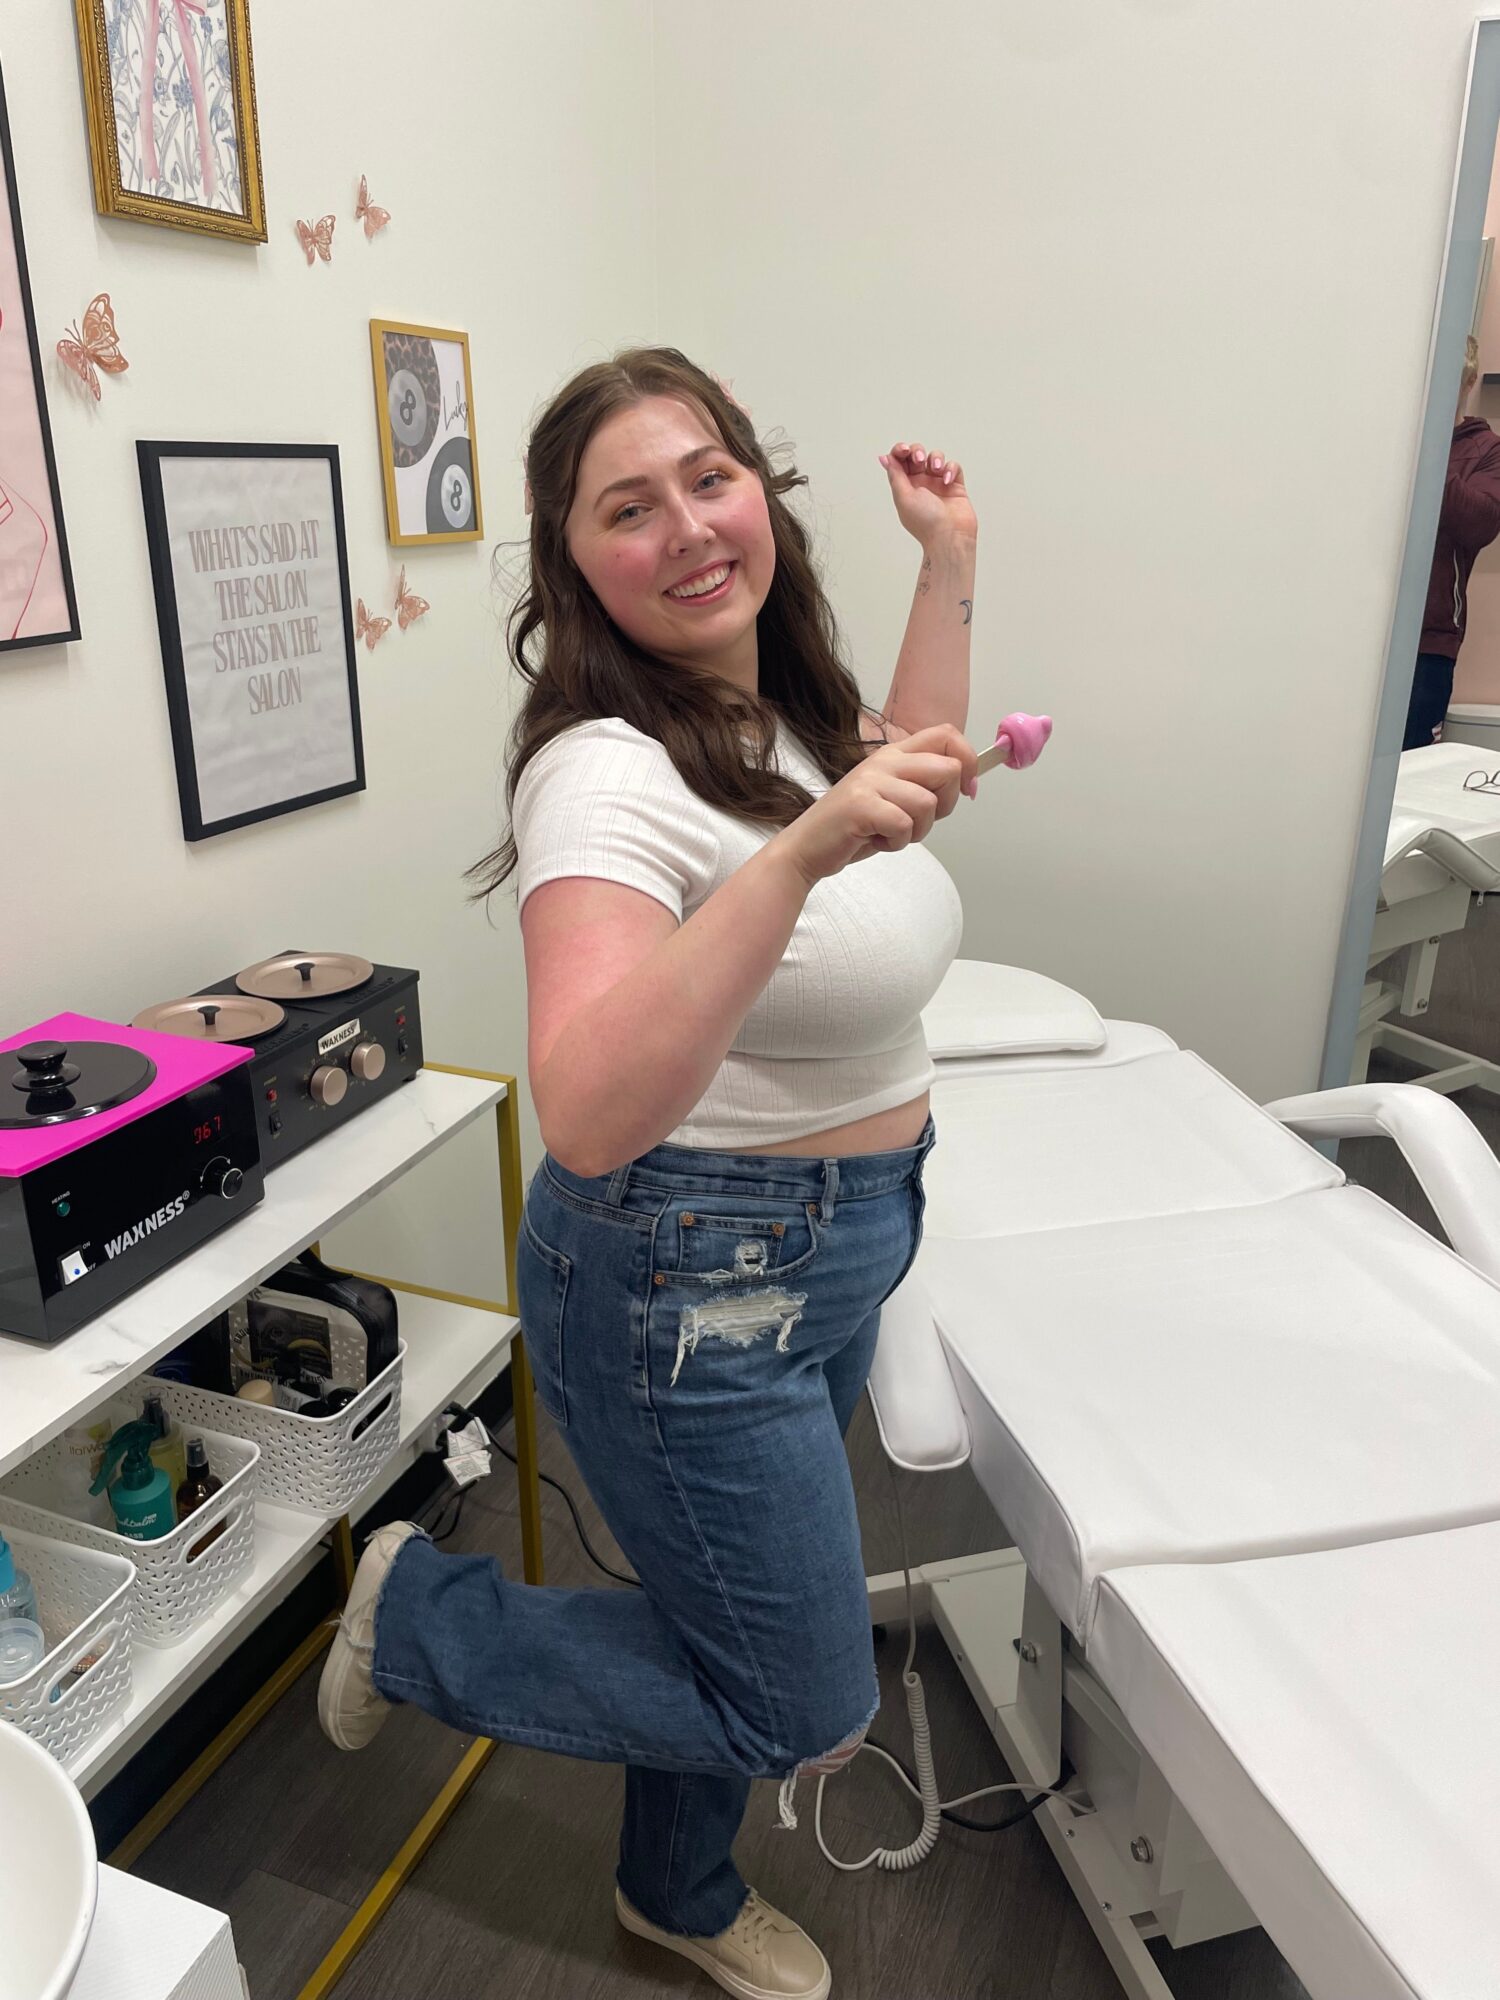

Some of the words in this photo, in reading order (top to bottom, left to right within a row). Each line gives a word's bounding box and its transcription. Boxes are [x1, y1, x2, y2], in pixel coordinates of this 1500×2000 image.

[399, 388, 417, 426] 8
[450, 479, 463, 512] 8
[188, 525, 259, 573] WHAT'S
[260, 522, 297, 565] SAID
[300, 519, 320, 560] AT
[214, 577, 253, 621] THE
[254, 569, 309, 616] SALON
[212, 625, 269, 673] STAYS
[268, 621, 288, 662] IN
[287, 616, 322, 657] THE
[247, 666, 302, 715] SALON
[320, 1025, 355, 1050] WAXNESS
[82, 1241, 91, 1250] ON
